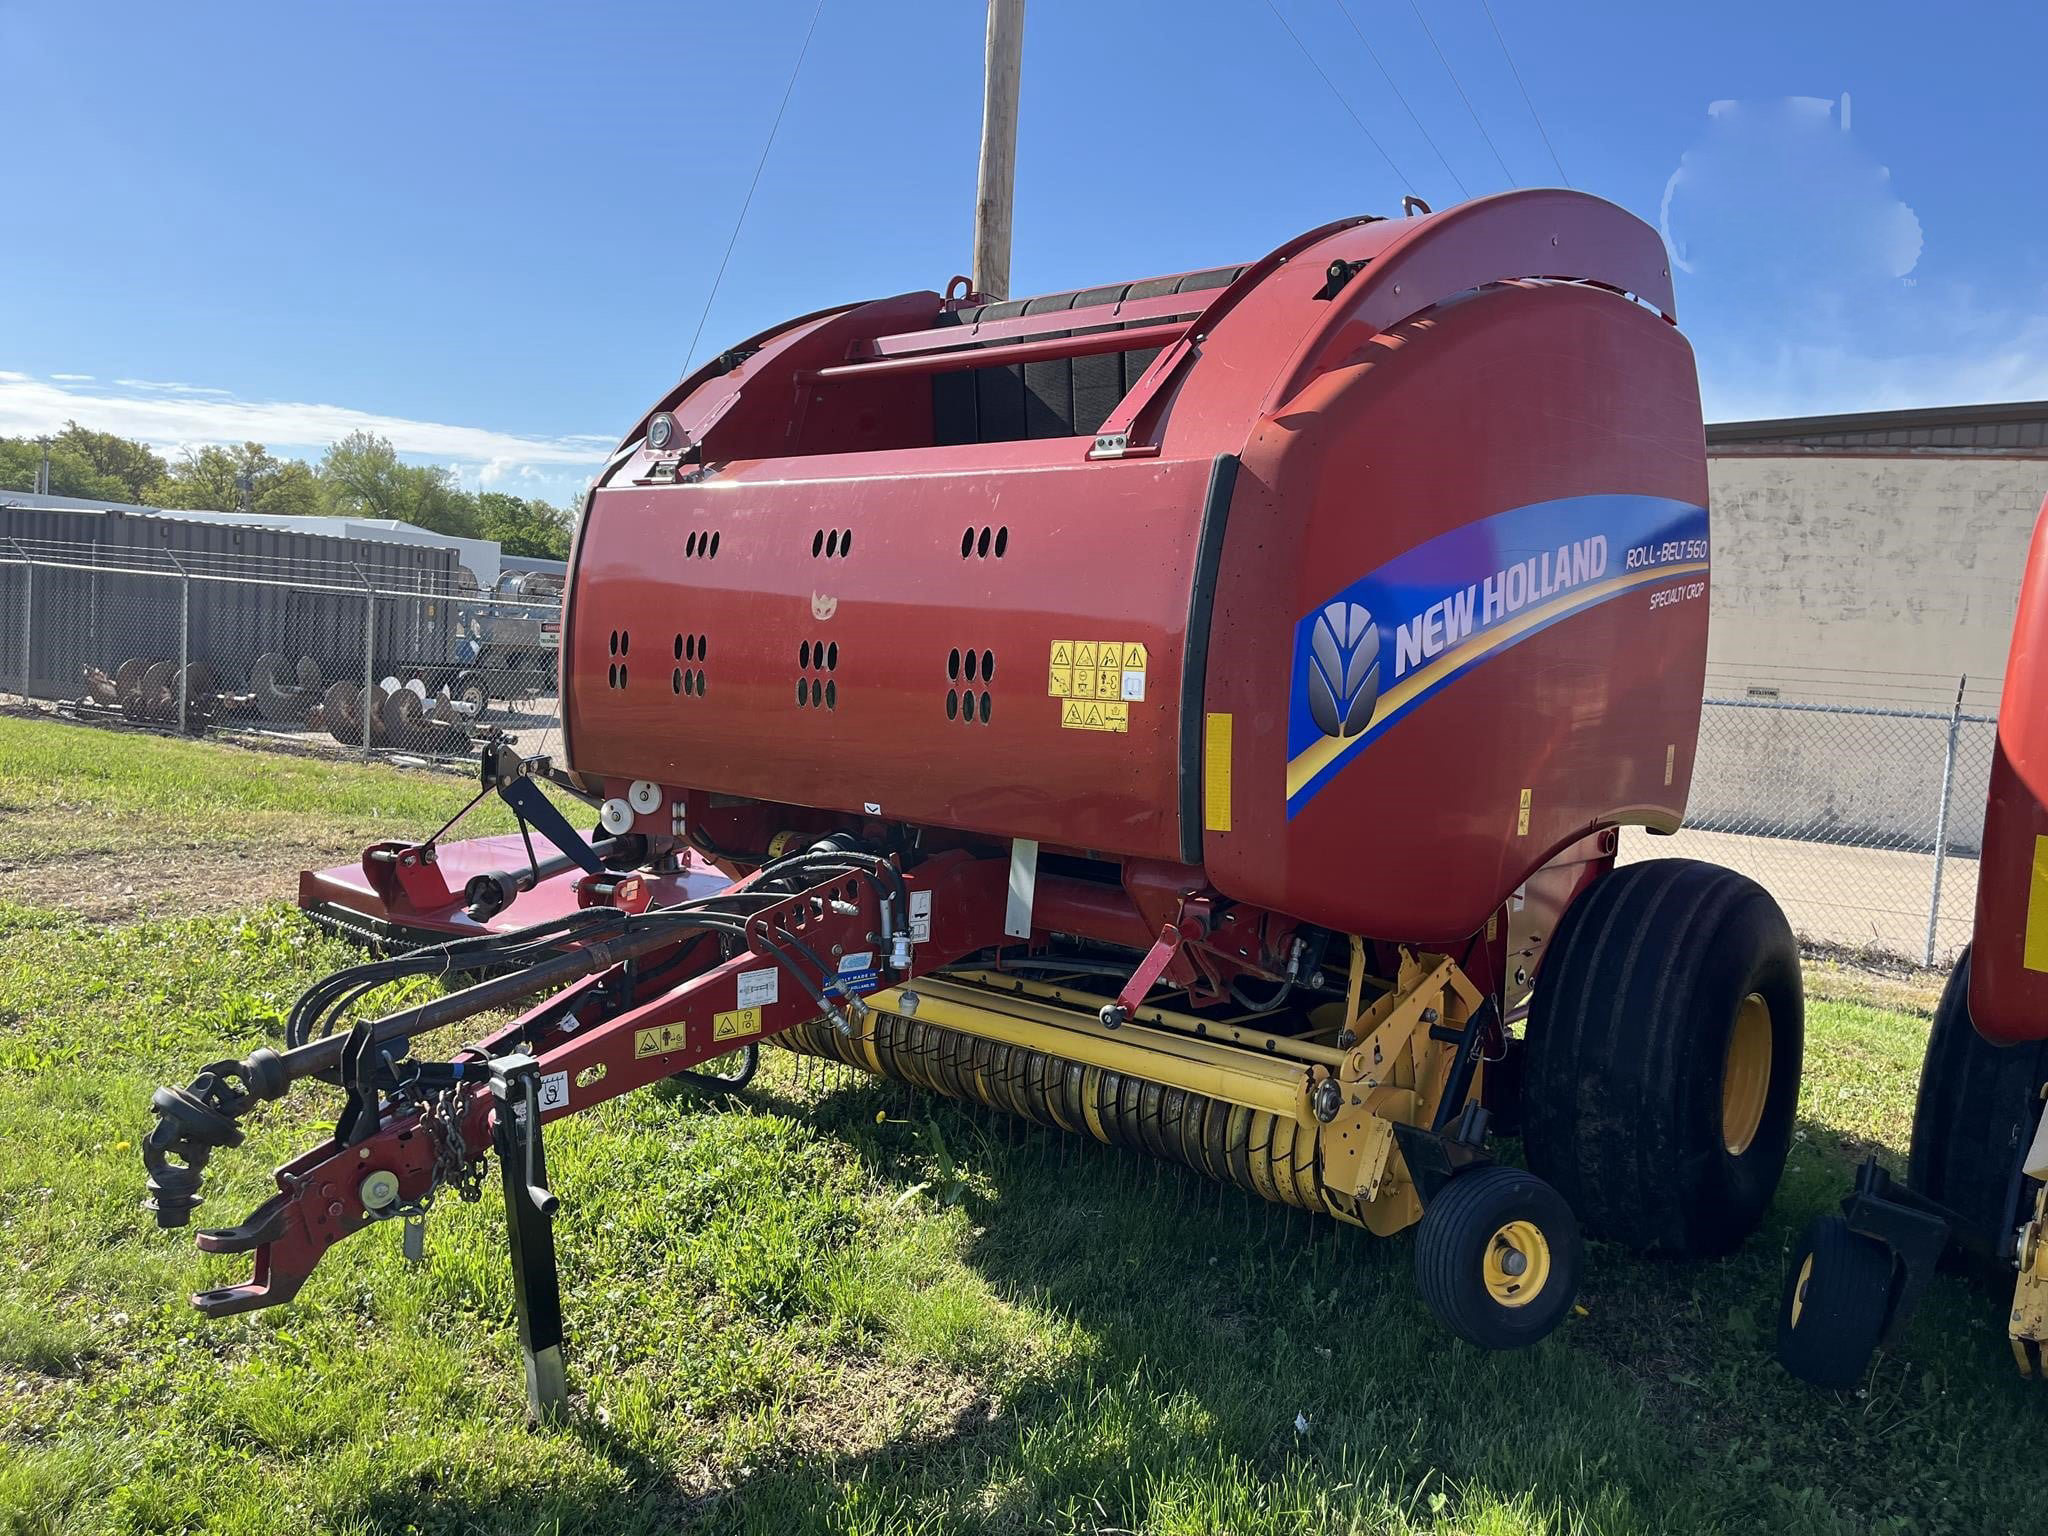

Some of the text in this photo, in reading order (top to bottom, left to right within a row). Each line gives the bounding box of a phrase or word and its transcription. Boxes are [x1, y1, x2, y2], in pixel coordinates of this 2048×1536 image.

[1686, 540, 1708, 559] 560
[1395, 534, 1608, 678] NEW HOLLAND
[1649, 581, 1705, 610] SPECIALTY CROP
